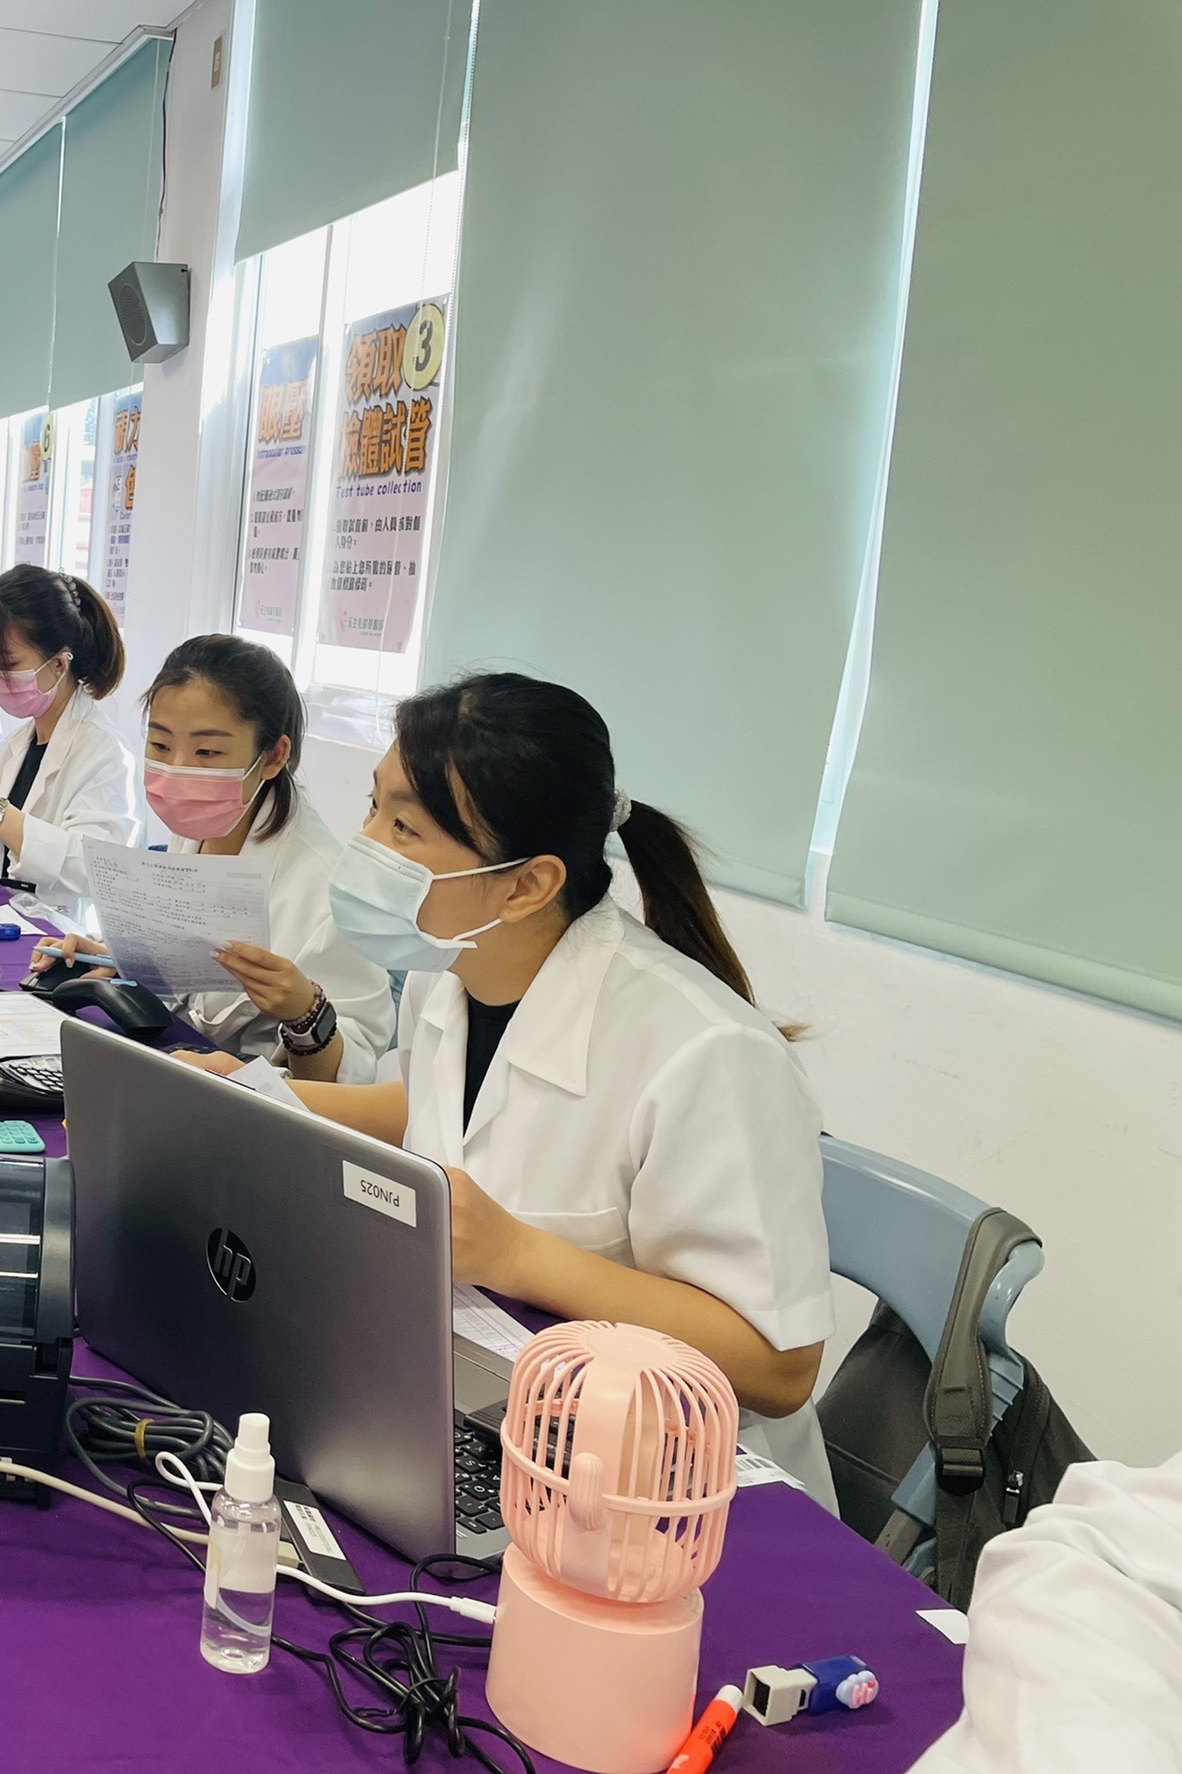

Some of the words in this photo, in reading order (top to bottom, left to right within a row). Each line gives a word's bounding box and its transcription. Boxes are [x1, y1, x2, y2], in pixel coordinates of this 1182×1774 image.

[345, 323, 407, 403] 領取
[413, 319, 433, 372] 3
[258, 380, 306, 443] 眼壓
[337, 395, 432, 477] 檢體試管
[336, 484, 353, 498] Test
[356, 484, 374, 497] tube
[377, 480, 422, 495] collection
[360, 1179, 400, 1208] PJN025
[212, 1227, 253, 1299] hp
